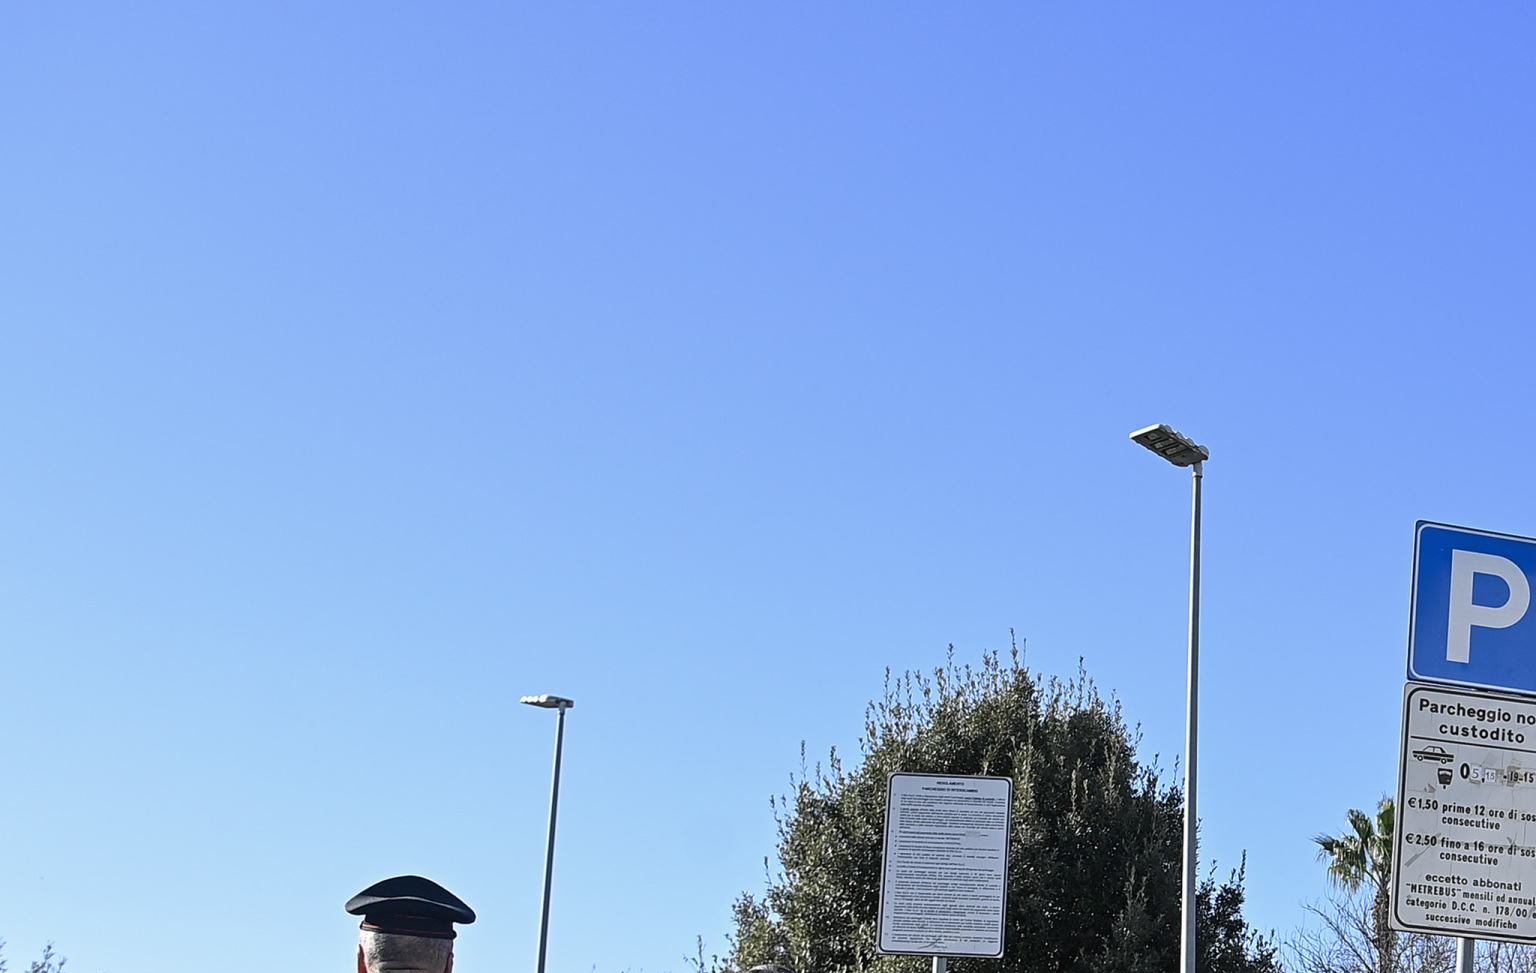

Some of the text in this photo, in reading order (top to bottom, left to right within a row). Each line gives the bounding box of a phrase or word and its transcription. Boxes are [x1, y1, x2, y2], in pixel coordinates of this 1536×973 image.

[1446, 549, 1531, 663] P
[1419, 698, 1511, 722] Parcheggio
[1439, 724, 1525, 744] custodito
[1442, 802, 1471, 814] prime
[1475, 804, 1485, 816] 12
[1489, 809, 1504, 818] ore
[1508, 809, 1517, 820] di
[1442, 816, 1500, 830] consecutive
[1441, 837, 1461, 849] fino
[1464, 842, 1469, 850] a
[1474, 840, 1484, 851] 16
[1488, 845, 1504, 854] ore
[1507, 844, 1517, 855] di
[1440, 852, 1498, 866] consecutive
[1425, 874, 1522, 891] eccetto abbonati
[1463, 891, 1493, 901] mensili
[1496, 893, 1506, 903] ed
[1406, 897, 1447, 909] categorie
[1452, 901, 1477, 912] D.C.C.
[1483, 906, 1490, 914] n.
[1496, 905, 1528, 918] 178/00
[1426, 914, 1517, 930] successive modifiche
